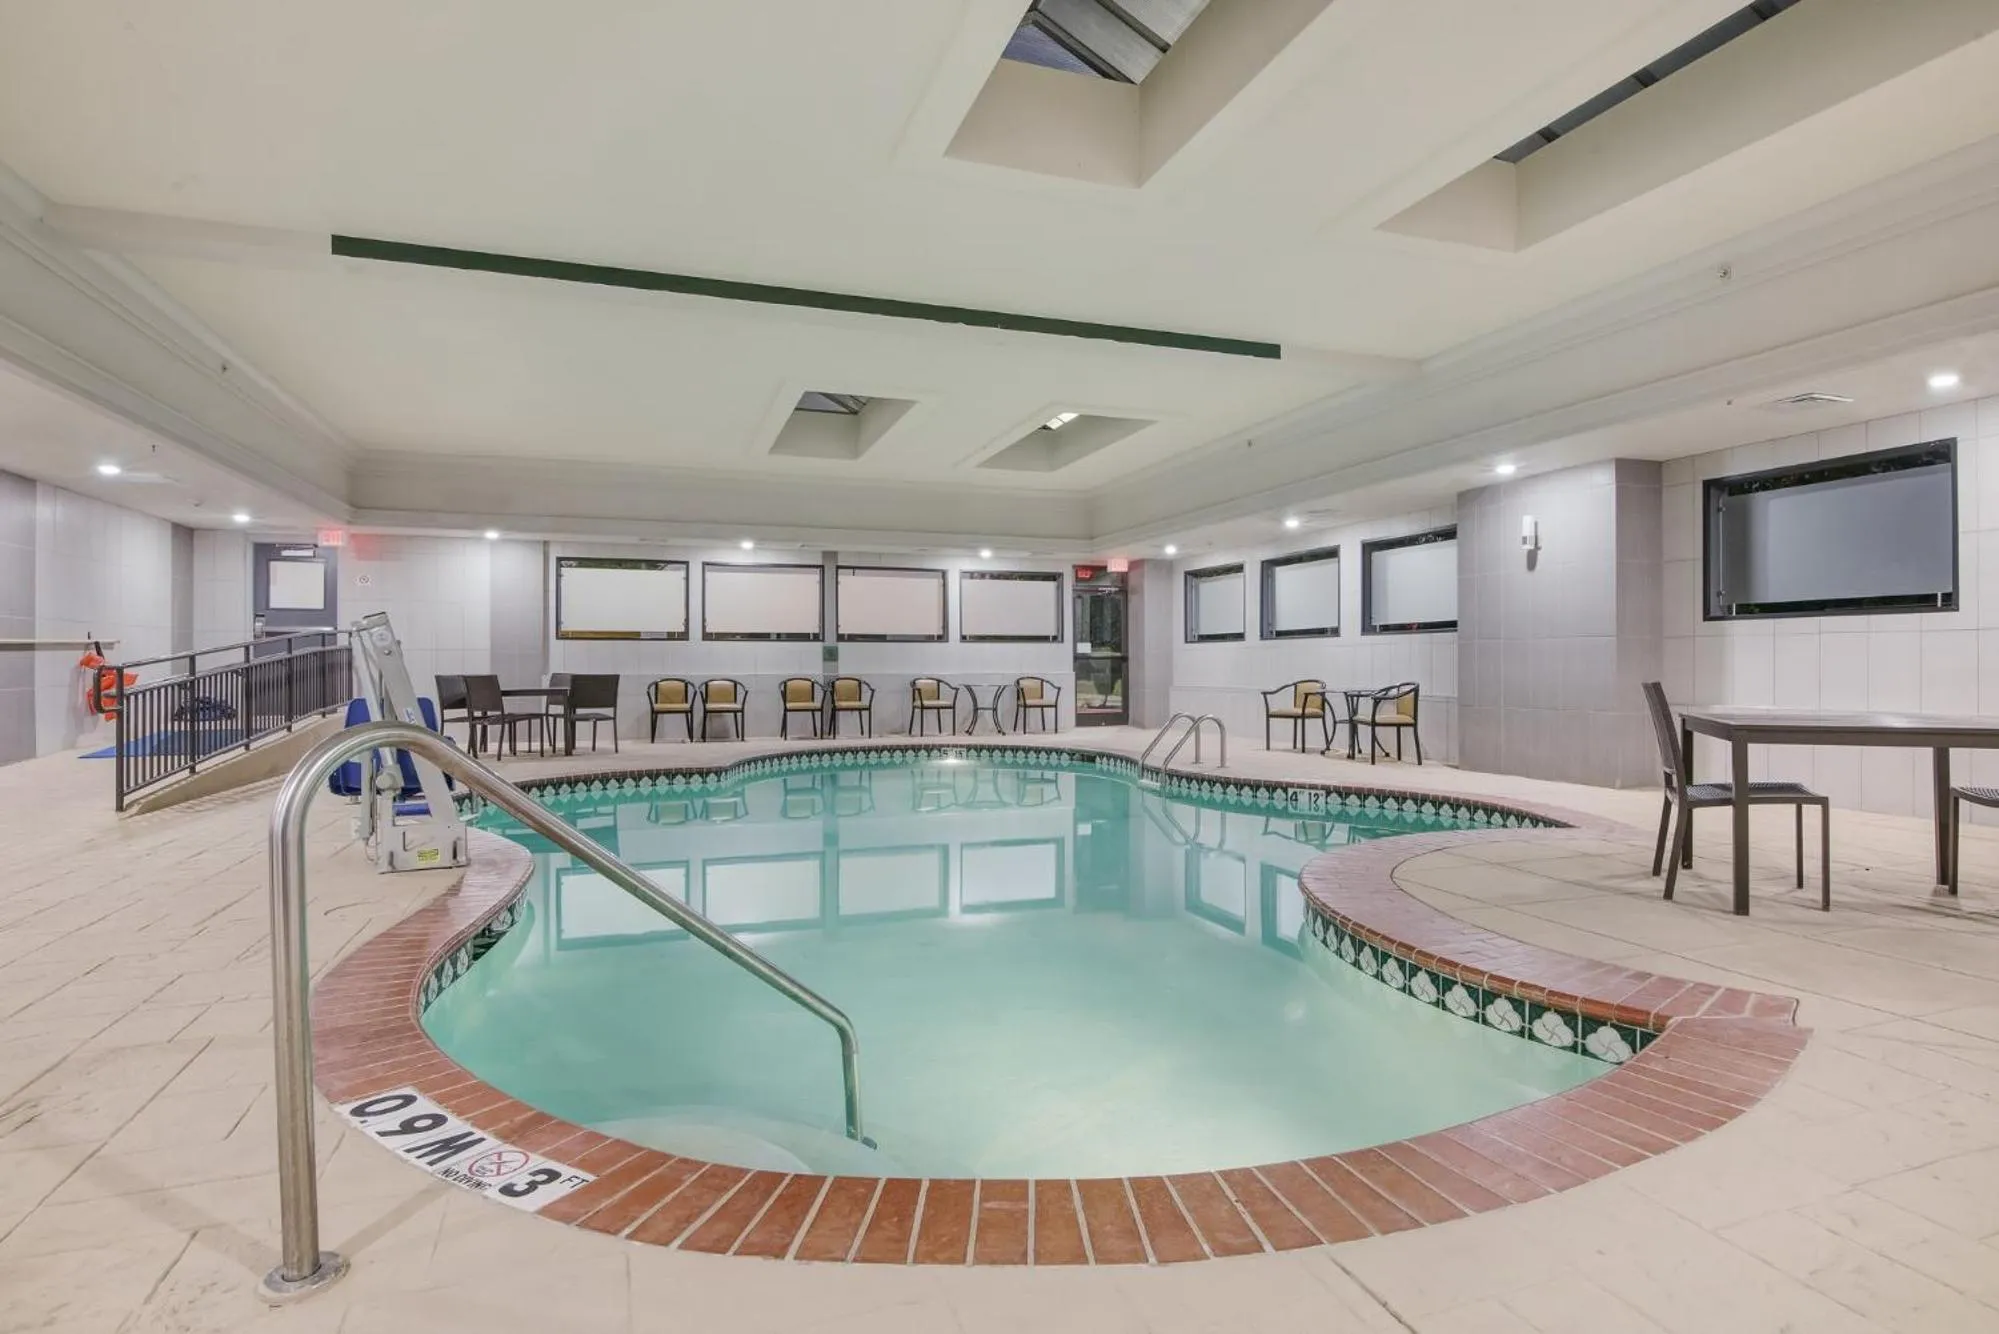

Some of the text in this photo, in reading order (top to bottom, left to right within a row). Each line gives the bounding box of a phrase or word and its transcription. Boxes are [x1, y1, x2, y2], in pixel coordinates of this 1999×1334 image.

[1290, 791, 1298, 802] 4
[499, 1168, 590, 1197] 3 FT
